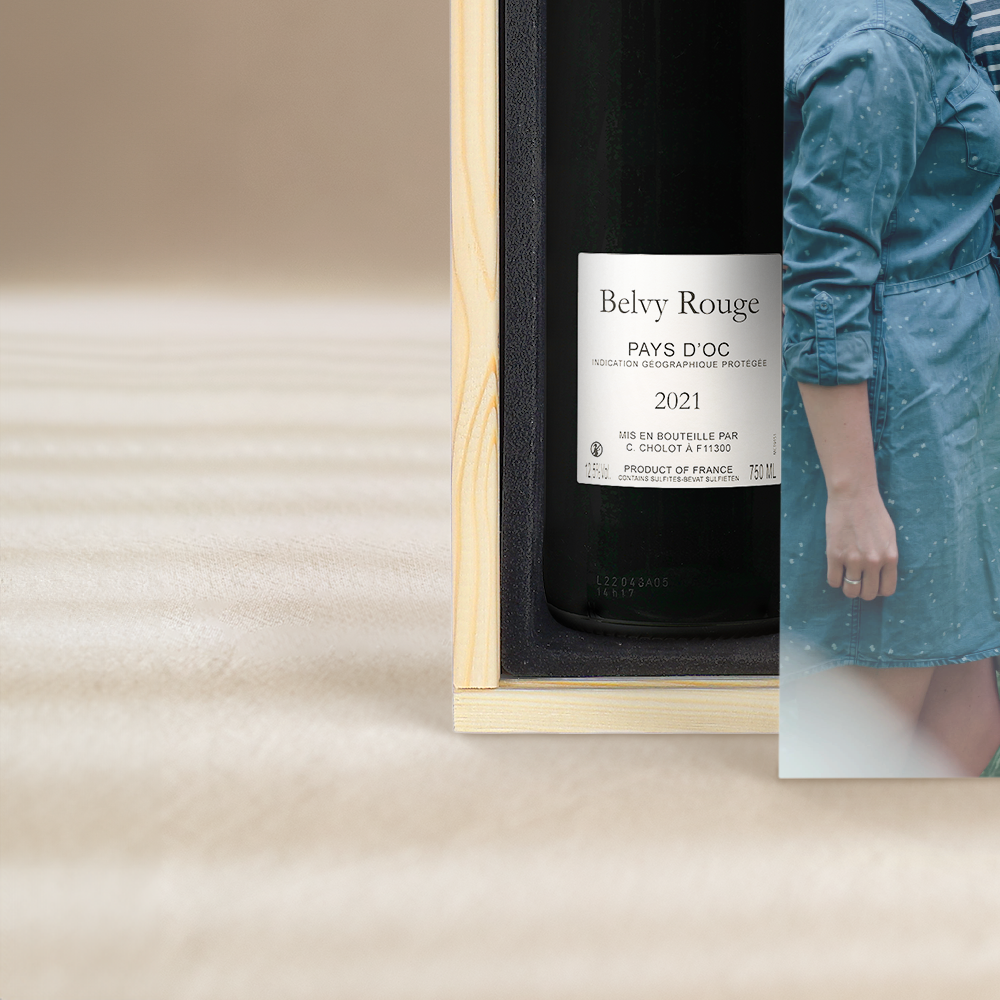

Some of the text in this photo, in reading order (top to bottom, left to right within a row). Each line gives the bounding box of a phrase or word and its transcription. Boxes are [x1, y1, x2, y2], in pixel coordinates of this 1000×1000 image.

[600, 288, 760, 323] Belvy Rouge
[628, 341, 730, 358] PAYS D’OC
[591, 358, 767, 369] INDICATION GÉOGRAPHIQUE PROTÉGÉE
[654, 391, 701, 411] 2021
[618, 430, 739, 442] MIS EN BOUTEILLE PAR
[625, 442, 636, 452] C.
[639, 443, 682, 454] CHOLOT
[685, 442, 694, 454] À
[623, 464, 733, 475] PRODUCT OF FRANCE
[749, 462, 777, 481] 750 ML
[617, 474, 649, 482] CONTAINS
[705, 475, 740, 483] SULFIETEN
